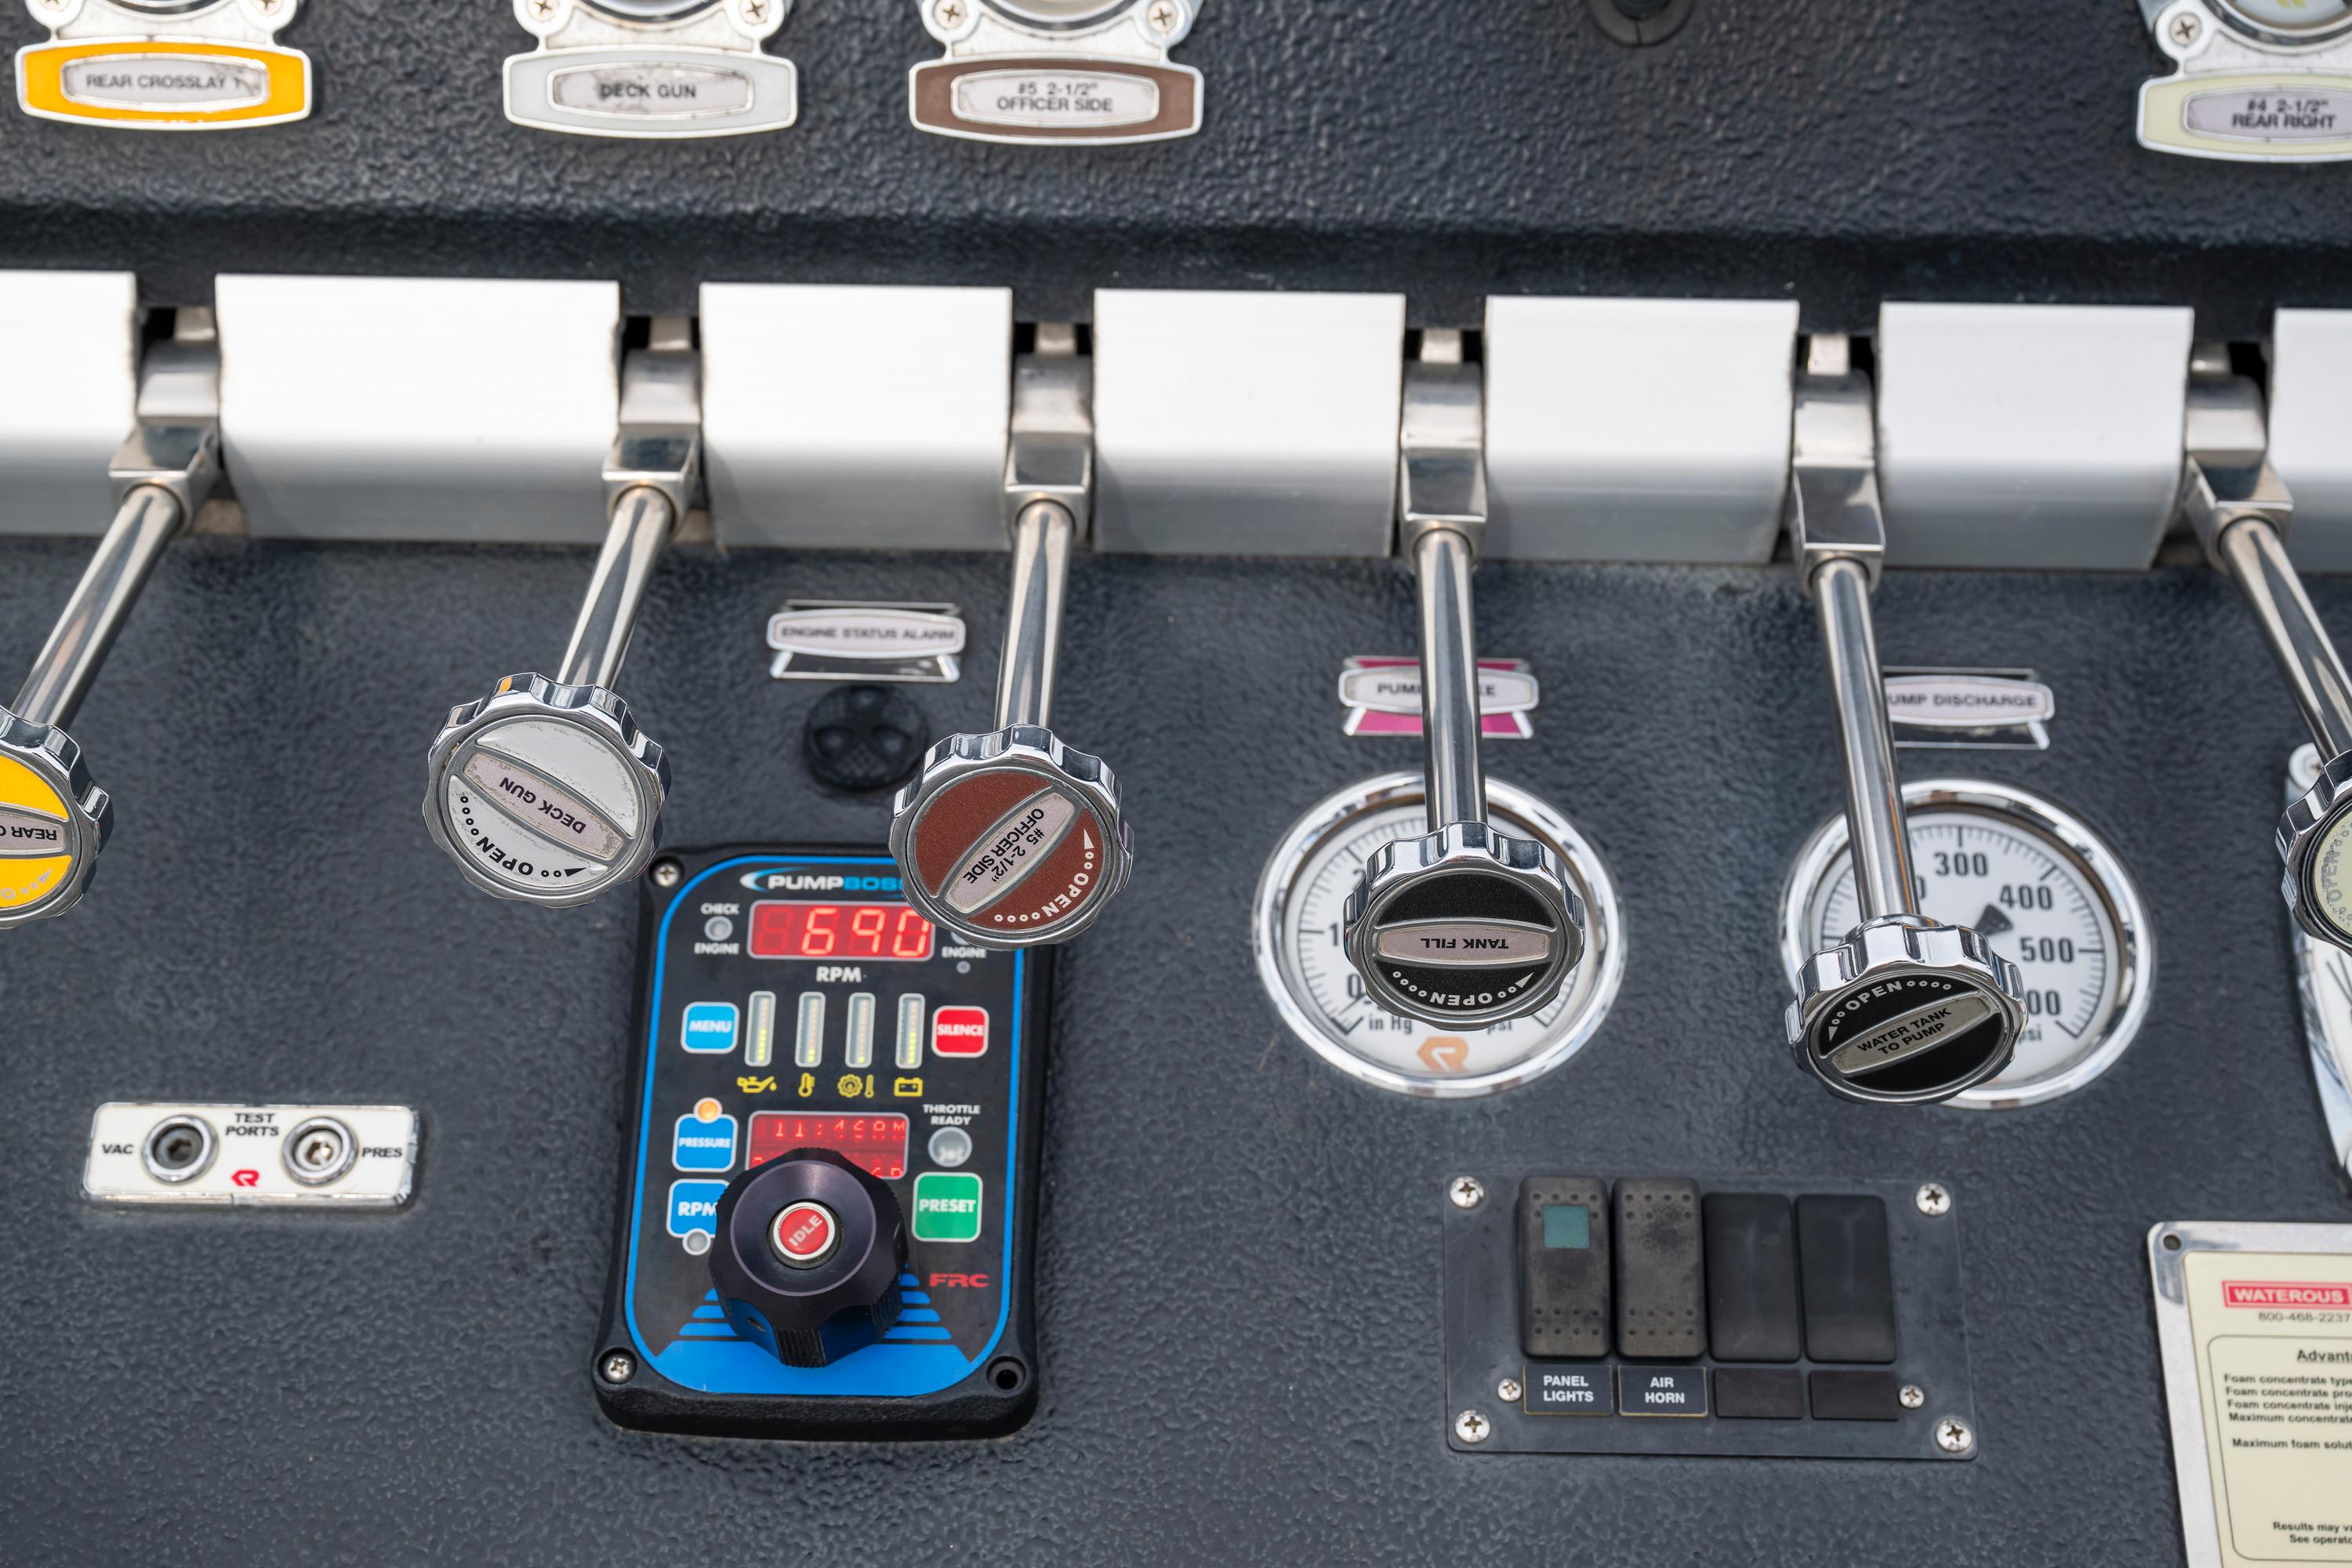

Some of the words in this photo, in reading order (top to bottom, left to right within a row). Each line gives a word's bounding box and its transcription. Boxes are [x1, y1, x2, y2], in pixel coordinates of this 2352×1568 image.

[86, 74, 132, 88] REAR
[137, 74, 226, 89] CROSSLAY
[1018, 82, 1037, 95] #5
[600, 83, 650, 99] DECK
[658, 84, 697, 98] GUN
[996, 96, 1069, 111] OFFICER
[1075, 97, 1113, 112] SIDE
[2247, 98, 2267, 111] #4
[2232, 114, 2278, 128] REAR
[2284, 114, 2336, 129] RIGHT
[782, 628, 837, 640] ENGINE
[843, 628, 897, 640] STATUS
[902, 628, 954, 641] ALARM
[1377, 682, 1421, 696] PUM
[1886, 693, 1928, 706] UMP
[1933, 694, 2036, 708] DISCHARGE
[499, 776, 537, 804] GUN
[538, 799, 586, 833] DECK
[10, 826, 56, 840] REAR
[990, 808, 1044, 857] OFFICER
[1026, 828, 1045, 846] #5
[476, 836, 534, 877] OPEN
[963, 855, 996, 884] SIDE
[1934, 851, 1989, 877] 300
[768, 875, 903, 891] PUMPBOS
[2321, 850, 2343, 903] OPEN
[1041, 872, 1090, 918] OPEN
[2000, 884, 2053, 910] 400
[700, 902, 739, 915] CHECK
[800, 907, 931, 956] 690
[694, 942, 739, 954] ENGINE
[1421, 938, 1456, 949] FILL
[1462, 938, 1509, 949] TANK
[2020, 937, 2074, 964] 500
[942, 946, 986, 958] ENGINE
[815, 966, 862, 982] RPM
[1430, 992, 1493, 1007] OPEN
[1845, 981, 1903, 1011] OPEN
[2026, 990, 2060, 1015] 00
[688, 1020, 733, 1034] MENU
[936, 1023, 985, 1037] SILENCE
[1369, 1017, 1383, 1030] in
[1391, 1017, 1413, 1034] Hg
[1857, 1025, 1911, 1051] WATER
[1910, 1007, 1952, 1029] TANK
[1877, 1042, 1900, 1055] TO
[1904, 1022, 1946, 1046] PUMP
[923, 1104, 981, 1115] THROTTLE
[234, 1112, 275, 1123] TEST
[930, 1116, 971, 1126] READY
[225, 1125, 279, 1137] PORTS
[101, 1144, 134, 1155] VAC
[678, 1137, 731, 1149] PRESSURE
[362, 1146, 403, 1158] PRES
[677, 1201, 718, 1216] RPM
[919, 1198, 977, 1213] PRESET
[789, 1214, 823, 1247] IDLE
[929, 1273, 990, 1287] FRC
[2234, 1287, 2344, 1304] WATEROUS
[2297, 1348, 2352, 1363] Advant
[1543, 1375, 1589, 1387] PANEL
[1650, 1377, 1675, 1388] AIR
[2224, 1374, 2256, 1383] Foam
[2259, 1375, 2326, 1385] concentrate
[1543, 1390, 1595, 1402] LIGHTS
[1645, 1392, 1686, 1403] HORN
[2226, 1386, 2257, 1396] Foam
[2261, 1388, 2328, 1397] concentrate
[2227, 1399, 2259, 1409] Foam
[2263, 1400, 2330, 1410] concentrate
[2229, 1412, 2285, 1421] Maximum
[2233, 1439, 2288, 1448] Maximum
[2291, 1439, 2320, 1449] foam
[2273, 1521, 2314, 1531] Results
[2318, 1524, 2339, 1534] may
[2290, 1534, 2310, 1544] See
